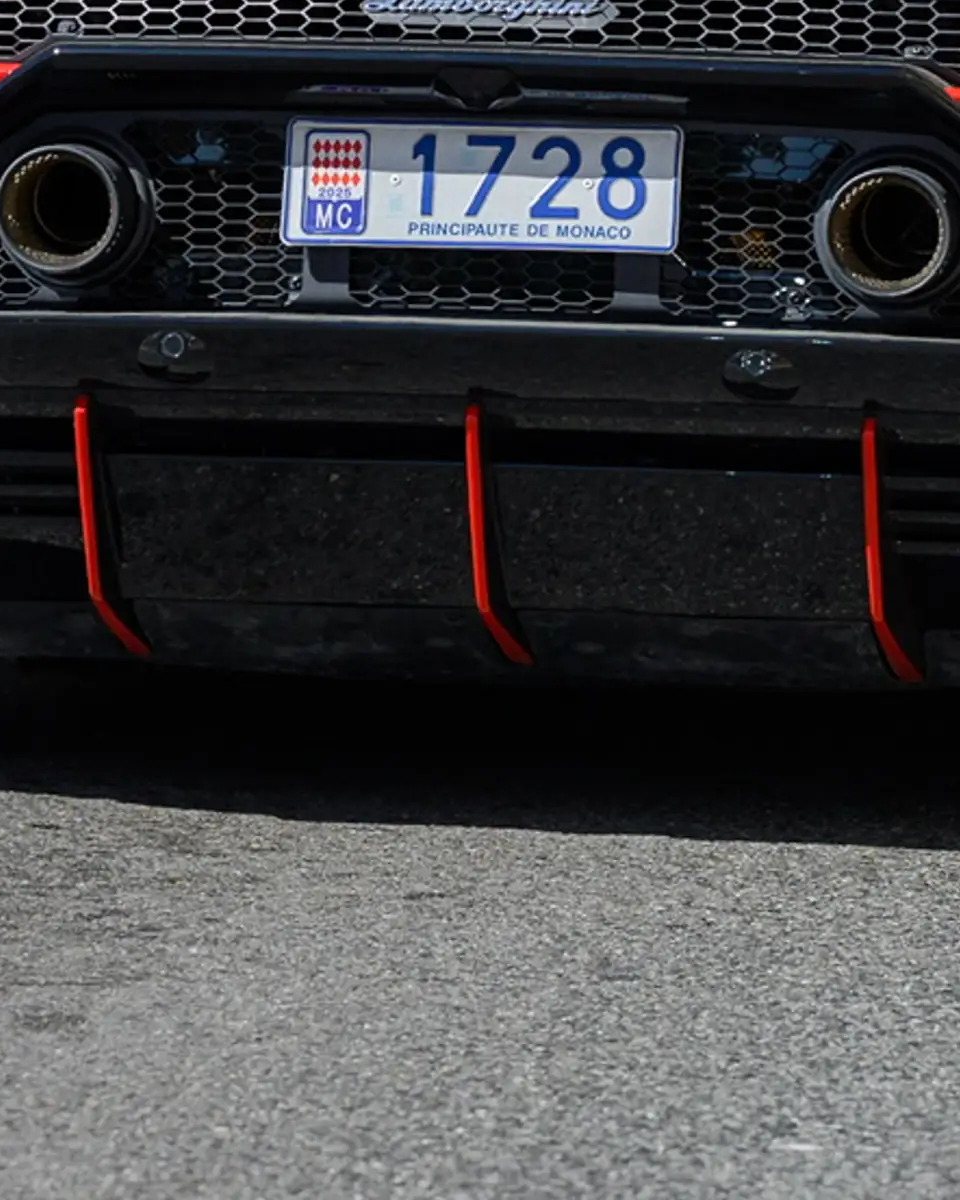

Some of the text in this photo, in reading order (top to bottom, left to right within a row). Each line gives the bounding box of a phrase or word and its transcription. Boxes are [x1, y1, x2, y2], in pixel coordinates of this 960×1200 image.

[412, 133, 647, 221] 1728
[318, 187, 352, 198] 2025
[315, 202, 353, 230] MC
[407, 222, 631, 240] PRINCIPAUTE DE MONACO
